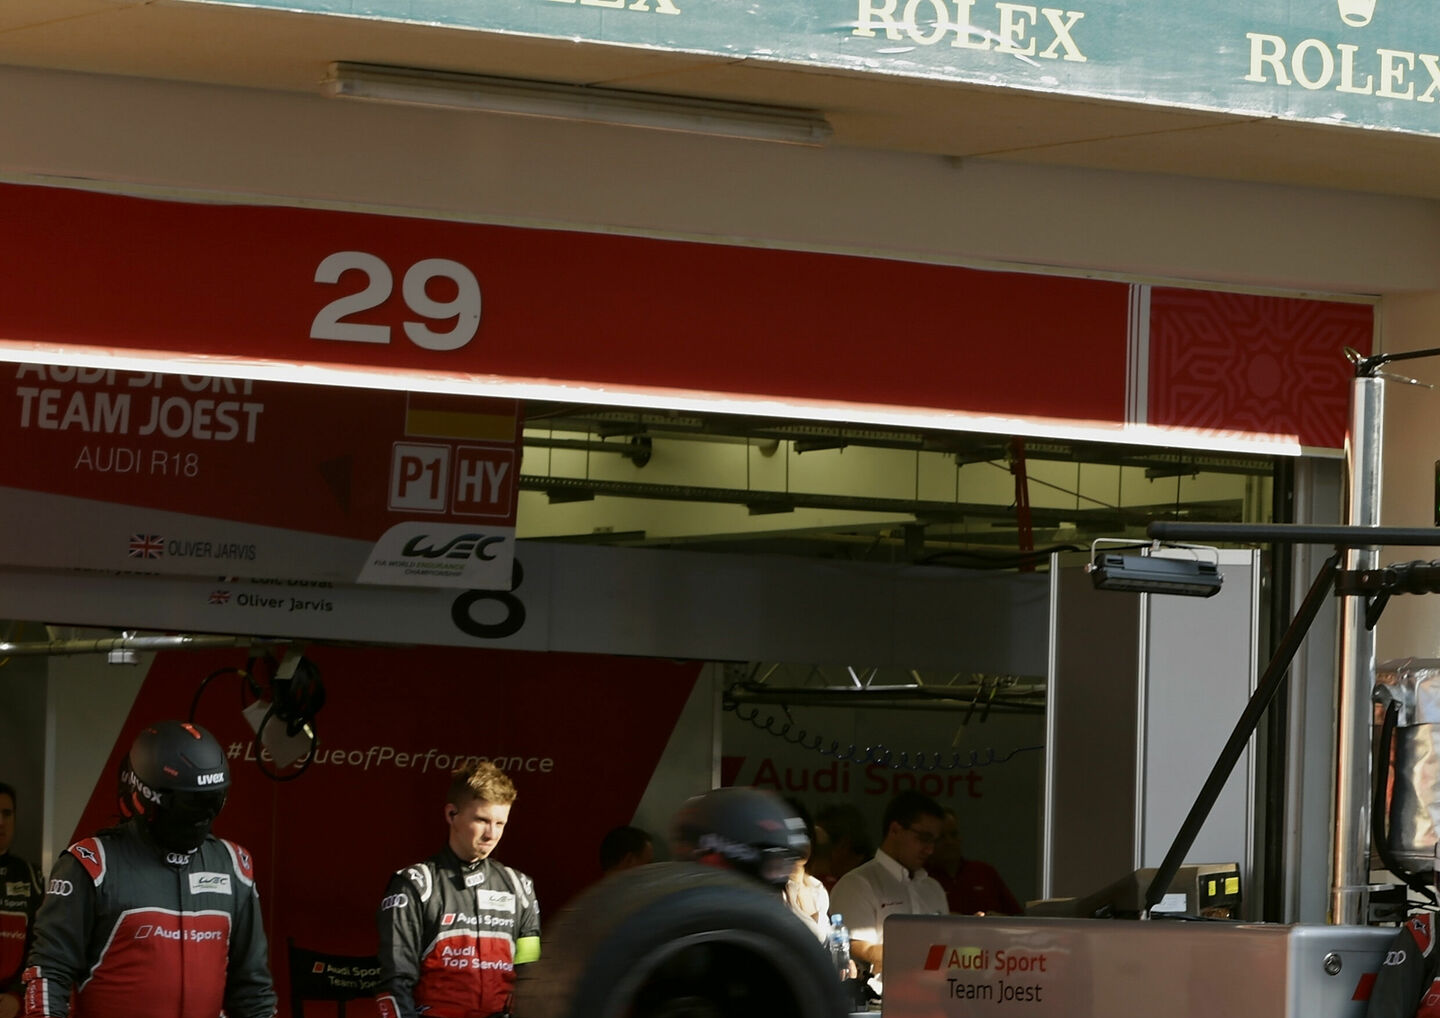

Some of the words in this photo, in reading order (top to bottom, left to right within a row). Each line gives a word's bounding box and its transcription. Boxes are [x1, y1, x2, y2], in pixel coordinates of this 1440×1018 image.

[852, 0, 1087, 62] ROLEX
[310, 250, 482, 351] 29
[16, 387, 131, 434] TEAM
[139, 396, 264, 443] JOEST
[74, 445, 141, 473] AUDI
[150, 450, 199, 477] R18
[397, 455, 442, 500] P1
[457, 459, 511, 504] HY
[167, 540, 212, 558] OLIVER
[214, 542, 256, 561] JARVIS
[402, 533, 506, 561] WEC
[237, 593, 284, 608] Oliver
[290, 595, 333, 612] Jarvis
[197, 772, 224, 786] uvex
[752, 758, 849, 793] Audi
[864, 763, 983, 798] Sport
[456, 912, 483, 925] Audi
[484, 915, 515, 928] Sport
[154, 925, 188, 940] Audi
[190, 928, 222, 942] Sport
[442, 946, 475, 957] Audi
[443, 957, 468, 970] Top
[948, 948, 989, 970] Audi
[994, 952, 1047, 976] Sport
[352, 965, 382, 978] Spor
[947, 978, 992, 1001] Team
[997, 981, 1042, 1003] Joest
